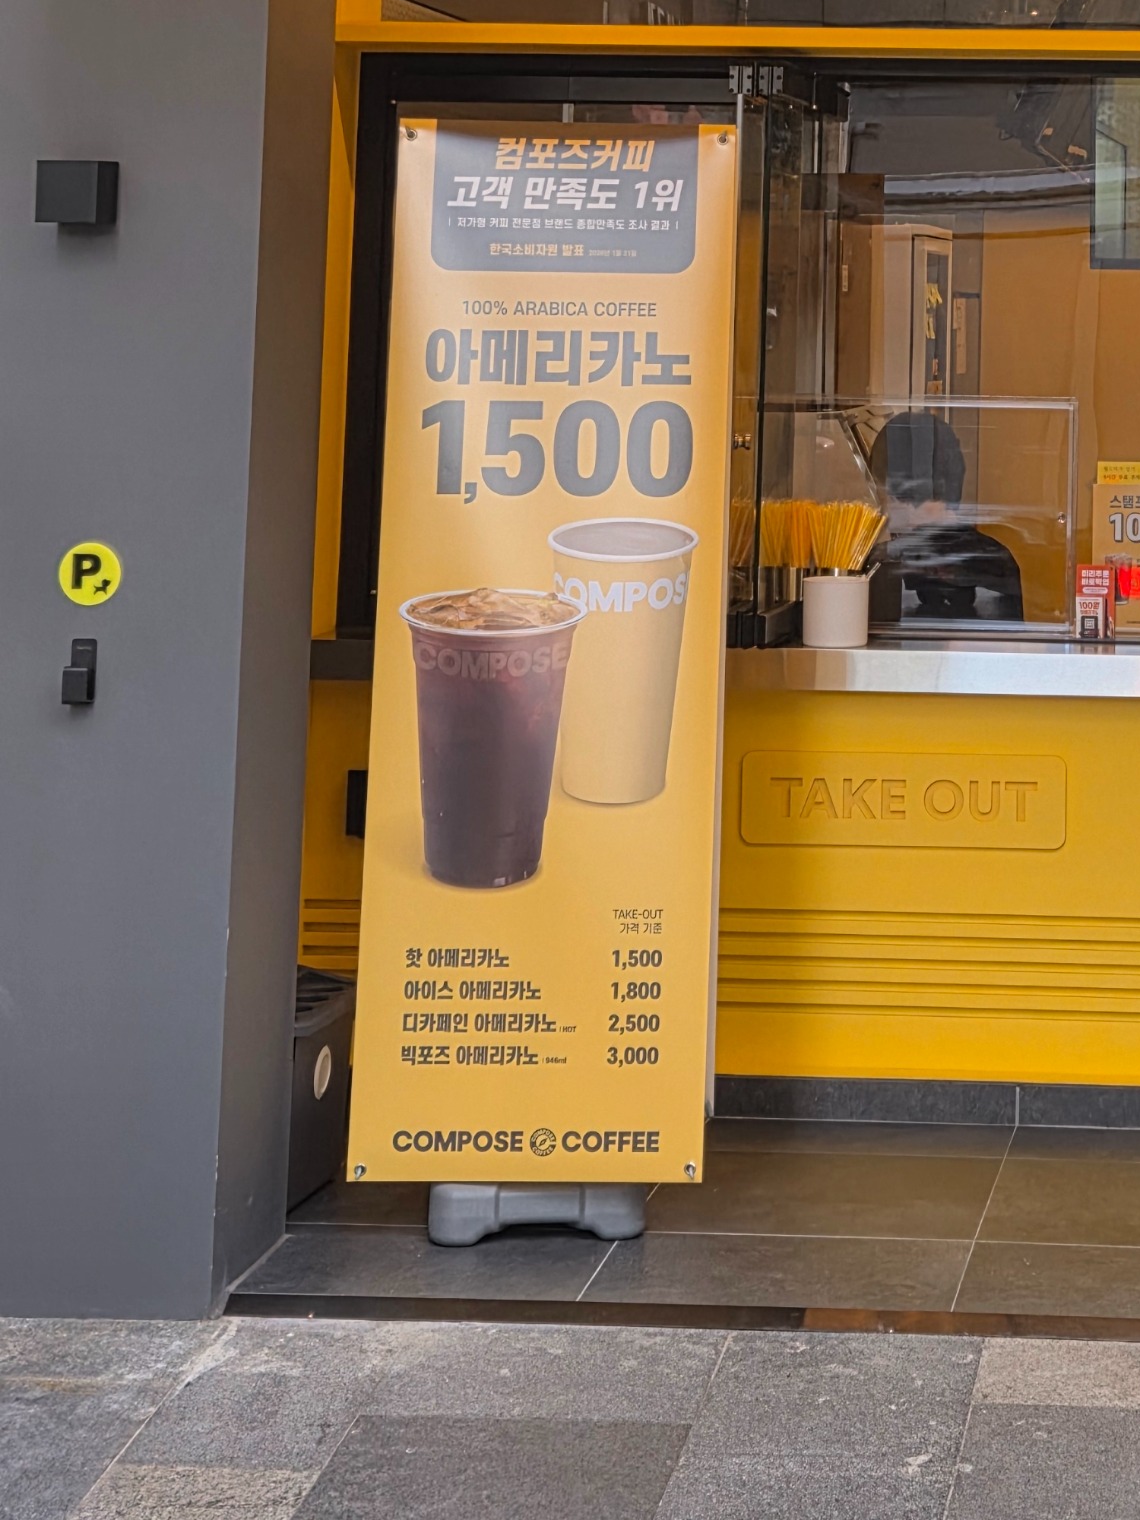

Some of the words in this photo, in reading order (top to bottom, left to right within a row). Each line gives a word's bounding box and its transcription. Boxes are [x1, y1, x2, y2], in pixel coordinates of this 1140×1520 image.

[494, 136, 656, 173] 컴포즈커피
[446, 176, 514, 210] 고객
[523, 176, 621, 212] 만족도
[633, 178, 684, 212] 1위
[457, 217, 487, 229] 저가형
[489, 217, 509, 229] 커피
[512, 218, 542, 230] 전문점
[544, 218, 574, 230] 브랜드
[576, 218, 625, 231] 종합만족도
[628, 219, 648, 231] 조사
[650, 219, 671, 231] 결과
[489, 243, 558, 256] 한국소비자원
[562, 243, 585, 257] 발표
[462, 300, 508, 316] 100%
[513, 300, 589, 317] ARABICA
[594, 301, 657, 317] COFFEE
[425, 328, 692, 387] 아메리카노
[421, 399, 694, 505] 1,500
[414, 640, 570, 680] COMPOSE
[769, 776, 907, 820] TAKE
[923, 779, 1038, 822] OUT
[612, 908, 664, 920] TAKE-OUT
[619, 923, 640, 935] 가격
[643, 923, 663, 935] 기준
[405, 948, 422, 968] 핫
[427, 948, 510, 968] 아메리카노
[611, 949, 663, 970] 1,500
[403, 980, 454, 1001] 아이스
[459, 980, 542, 1001] 아메리카노
[610, 981, 662, 1002] 1,800
[402, 1013, 469, 1033] 디카페인
[474, 1013, 557, 1034] 아메리카노
[608, 1014, 660, 1035] 2,500
[400, 1045, 451, 1066] 빅포즈
[456, 1045, 539, 1066] 아메리카노
[606, 1046, 659, 1068] 3,000
[392, 1130, 524, 1153] COMPOSE
[561, 1130, 660, 1153] COFFEE
